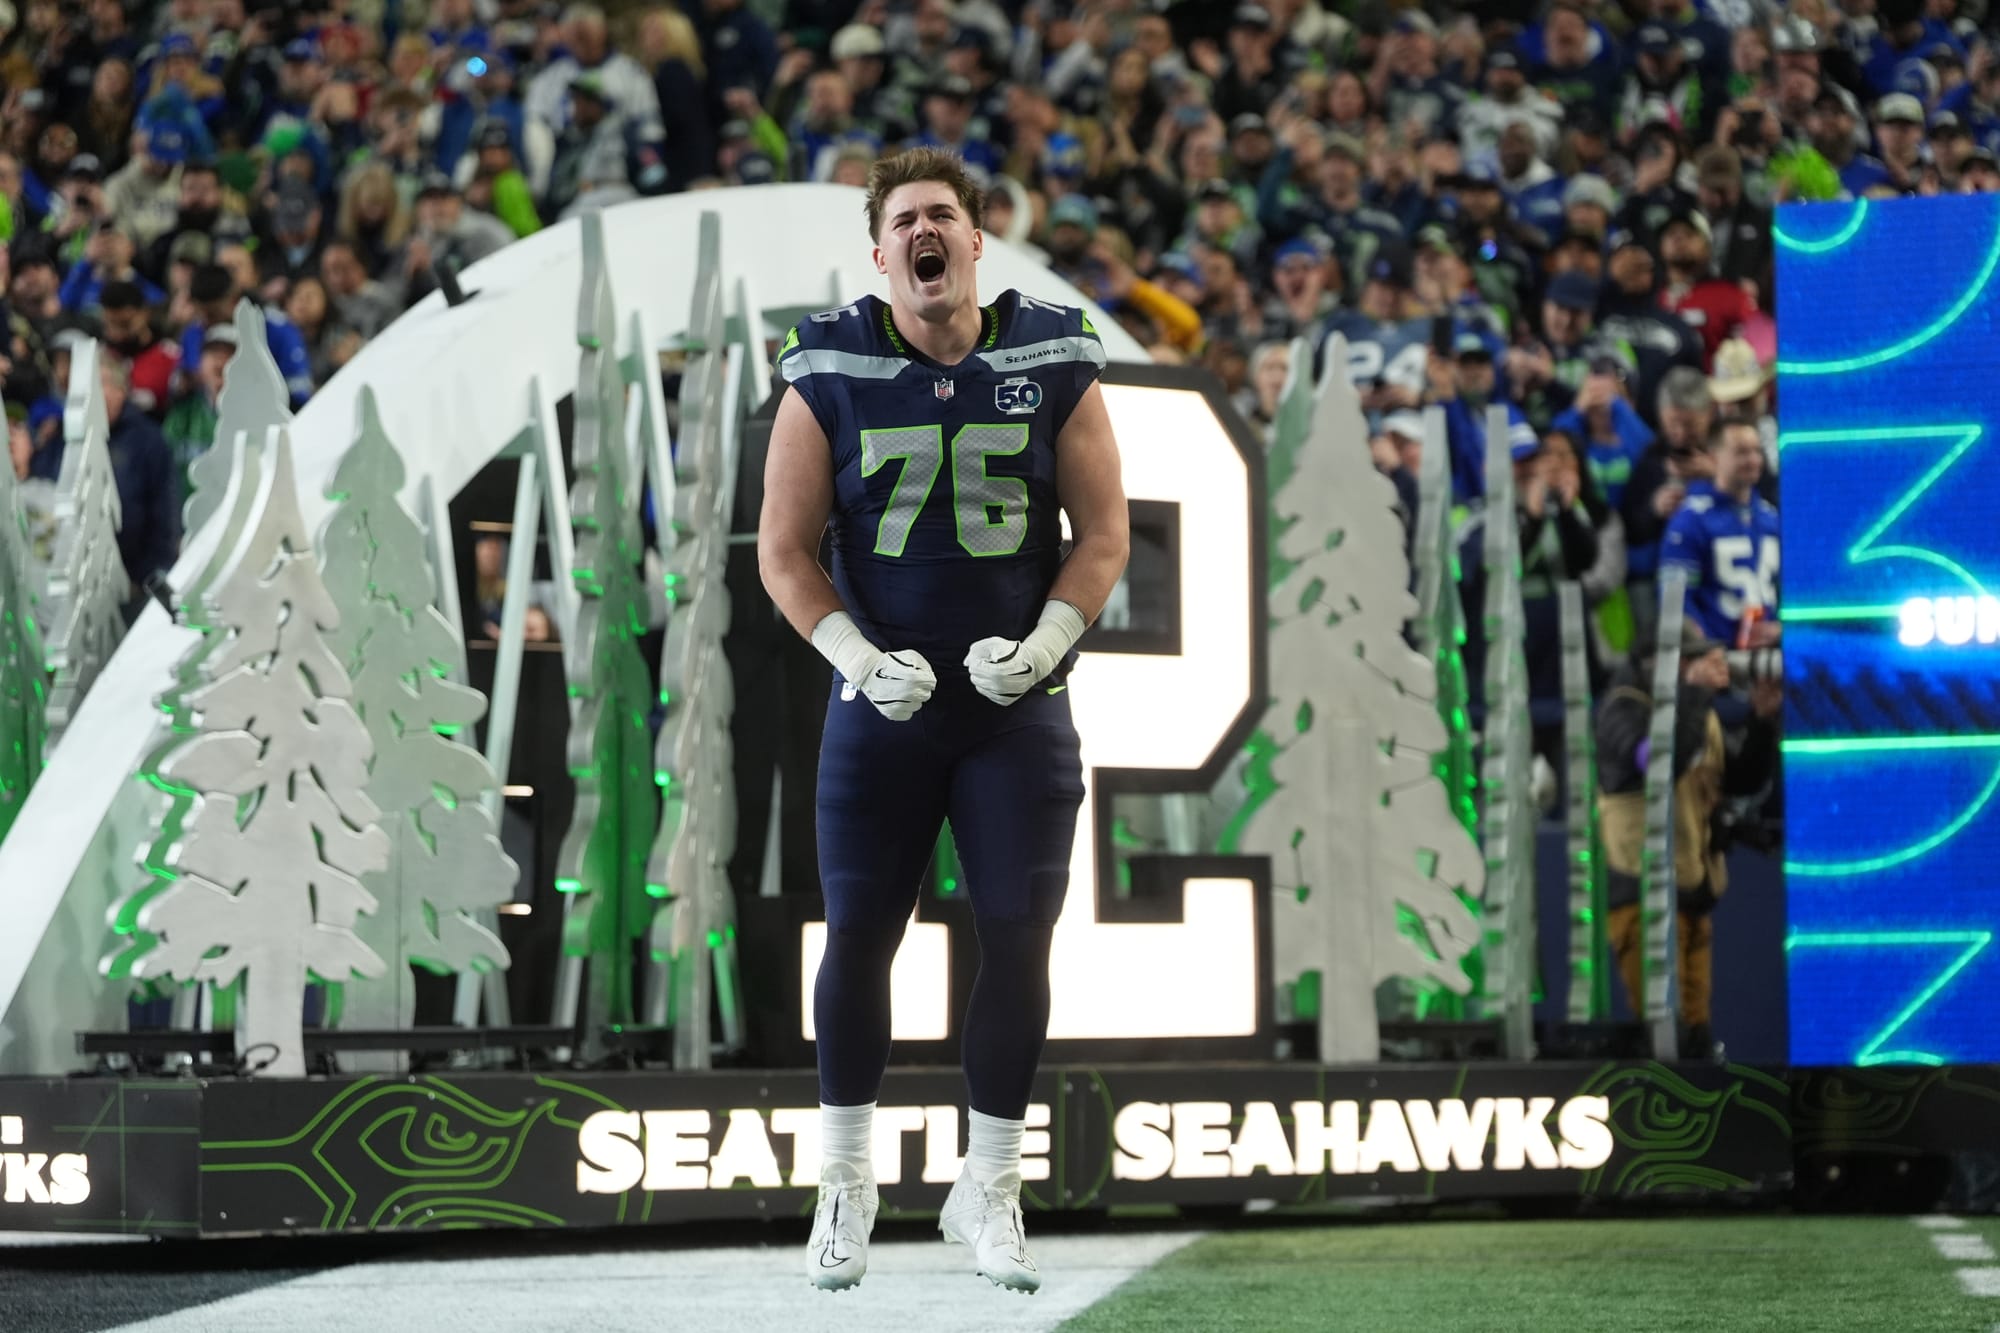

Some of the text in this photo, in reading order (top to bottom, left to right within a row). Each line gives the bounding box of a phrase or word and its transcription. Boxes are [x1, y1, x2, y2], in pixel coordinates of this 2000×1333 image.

[1005, 347, 1067, 364] SEAHAWKS
[995, 382, 1043, 411] 50
[860, 423, 1030, 558] 76
[1113, 1095, 1613, 1180] SEAHAWKS
